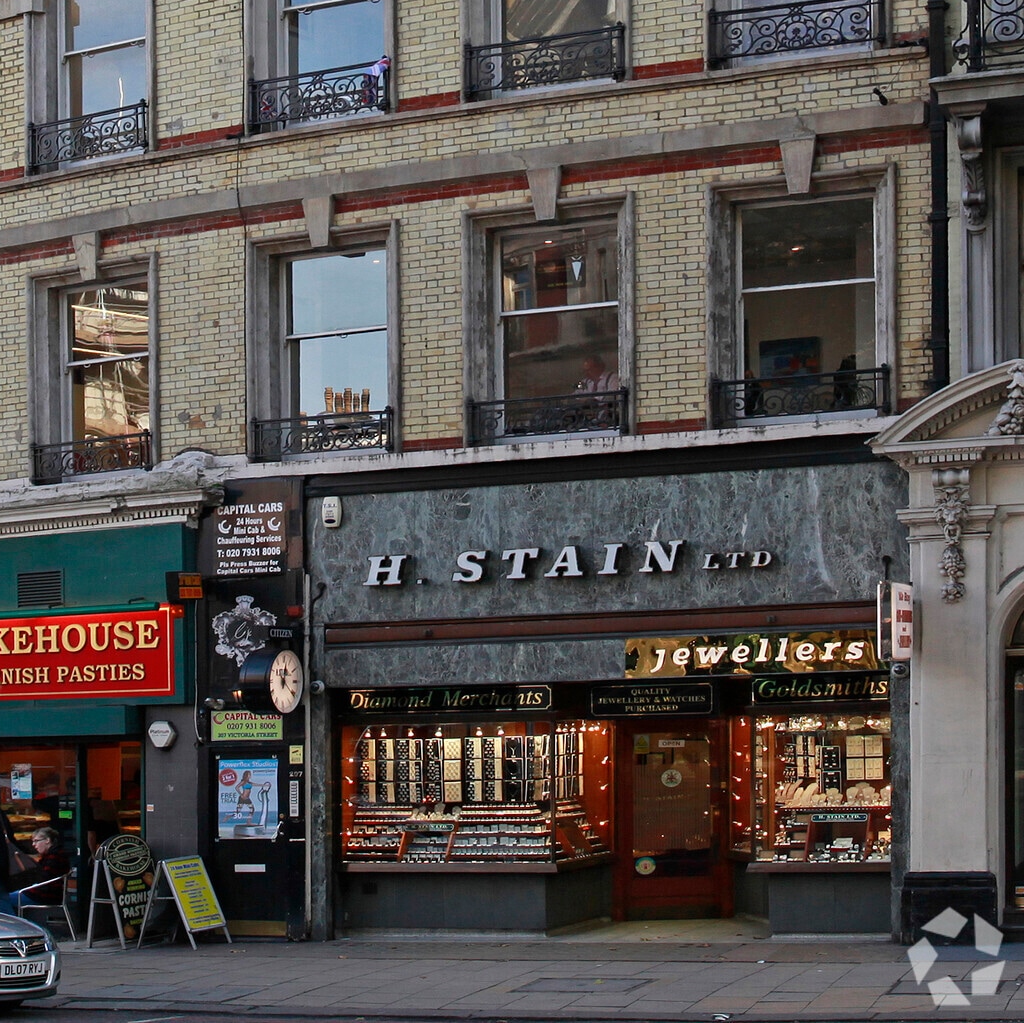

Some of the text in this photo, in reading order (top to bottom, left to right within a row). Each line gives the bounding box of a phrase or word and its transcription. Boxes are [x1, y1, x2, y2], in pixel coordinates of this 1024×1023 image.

[217, 502, 283, 516] CAPITAL CARS
[236, 517, 263, 526] 24 Hours
[233, 527, 246, 535] Mini
[247, 526, 260, 534] Cab
[217, 534, 282, 545] Chauffeuring Services
[217, 546, 281, 557] T: 020 7931 8006
[362, 539, 774, 587] H. STAIN LTD
[269, 628, 294, 638] CITIZEN
[649, 637, 866, 674] jewellers
[57, 663, 146, 683] PASTIES
[630, 687, 671, 696] QUALITY
[758, 678, 888, 699] Goldsmiths
[350, 689, 543, 710] Diamond Merchants
[597, 697, 652, 705] JEWELLERY
[663, 695, 706, 703] WATCHES
[625, 704, 679, 713] PURCHASED
[224, 712, 259, 721] CAPITAL
[245, 722, 257, 730] 931
[259, 722, 277, 730] 8006
[4, 962, 43, 976] DL07 RYJ
